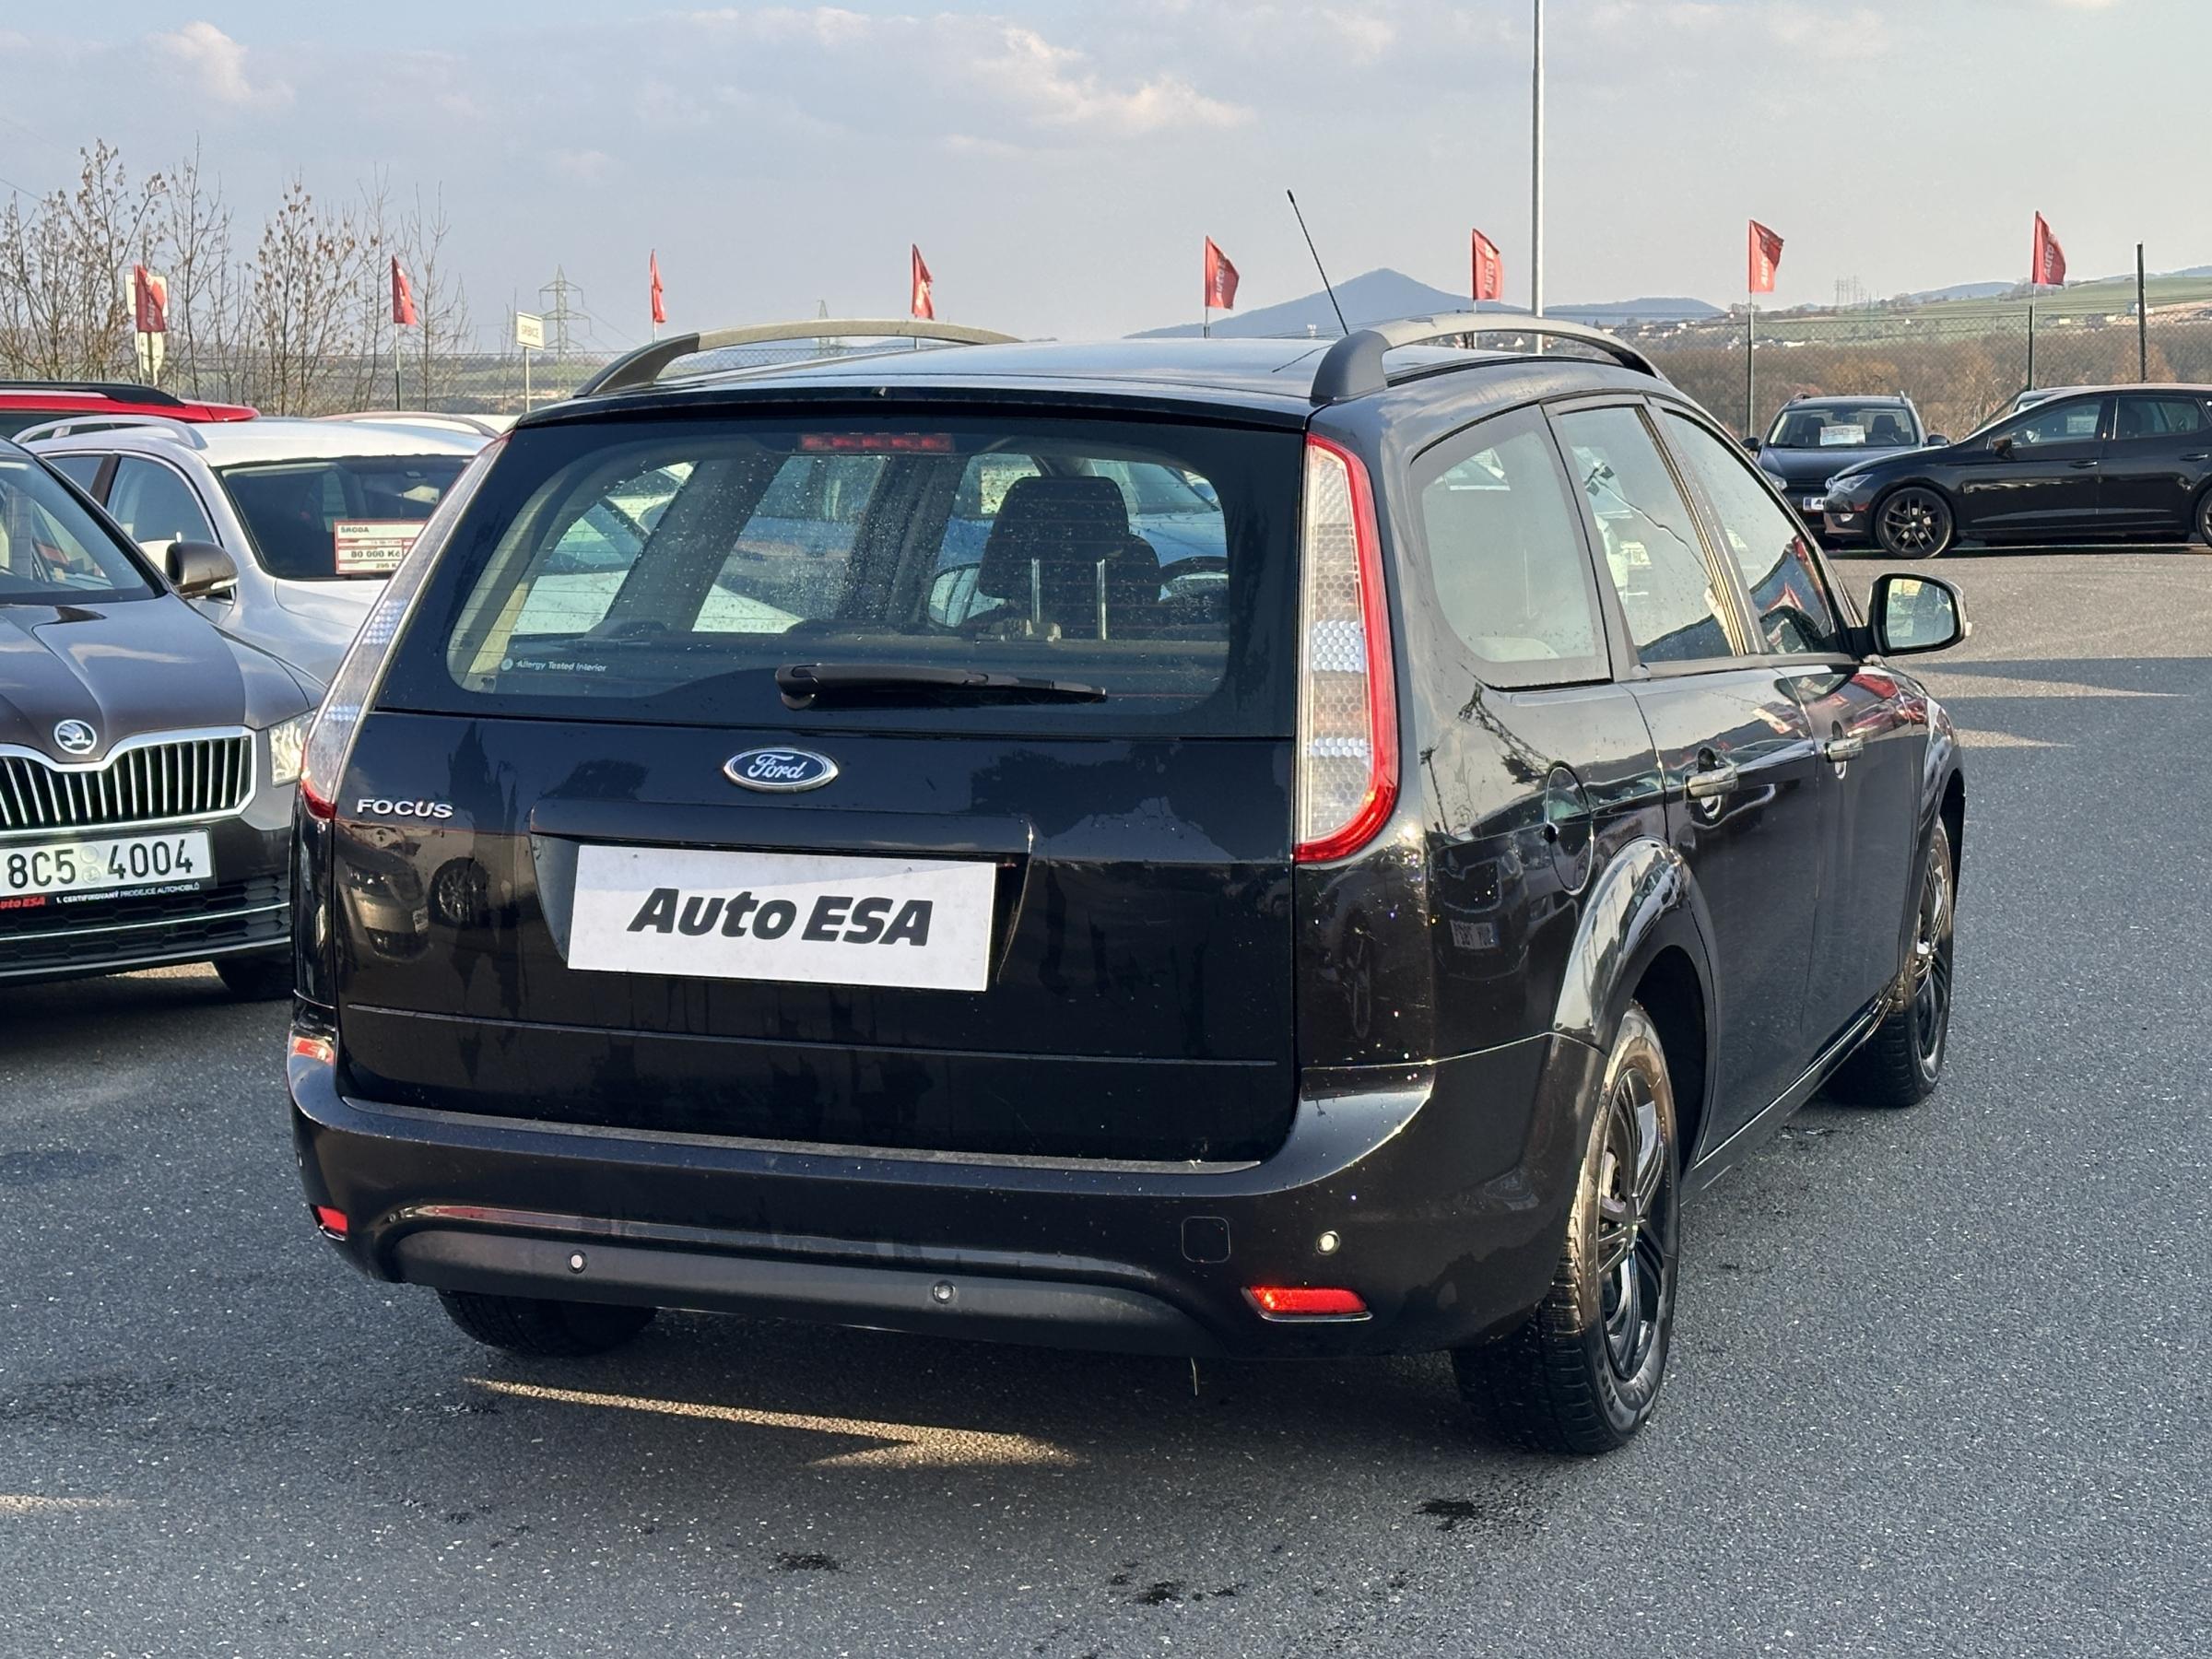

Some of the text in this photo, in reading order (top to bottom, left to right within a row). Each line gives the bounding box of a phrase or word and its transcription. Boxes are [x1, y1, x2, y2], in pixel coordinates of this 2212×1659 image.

[747, 753, 808, 779] Ford
[357, 798, 453, 818] FOCUS
[7, 838, 194, 889] 8C5 4004
[0, 896, 46, 910] uto ESA
[626, 887, 934, 947] Auto ESA
